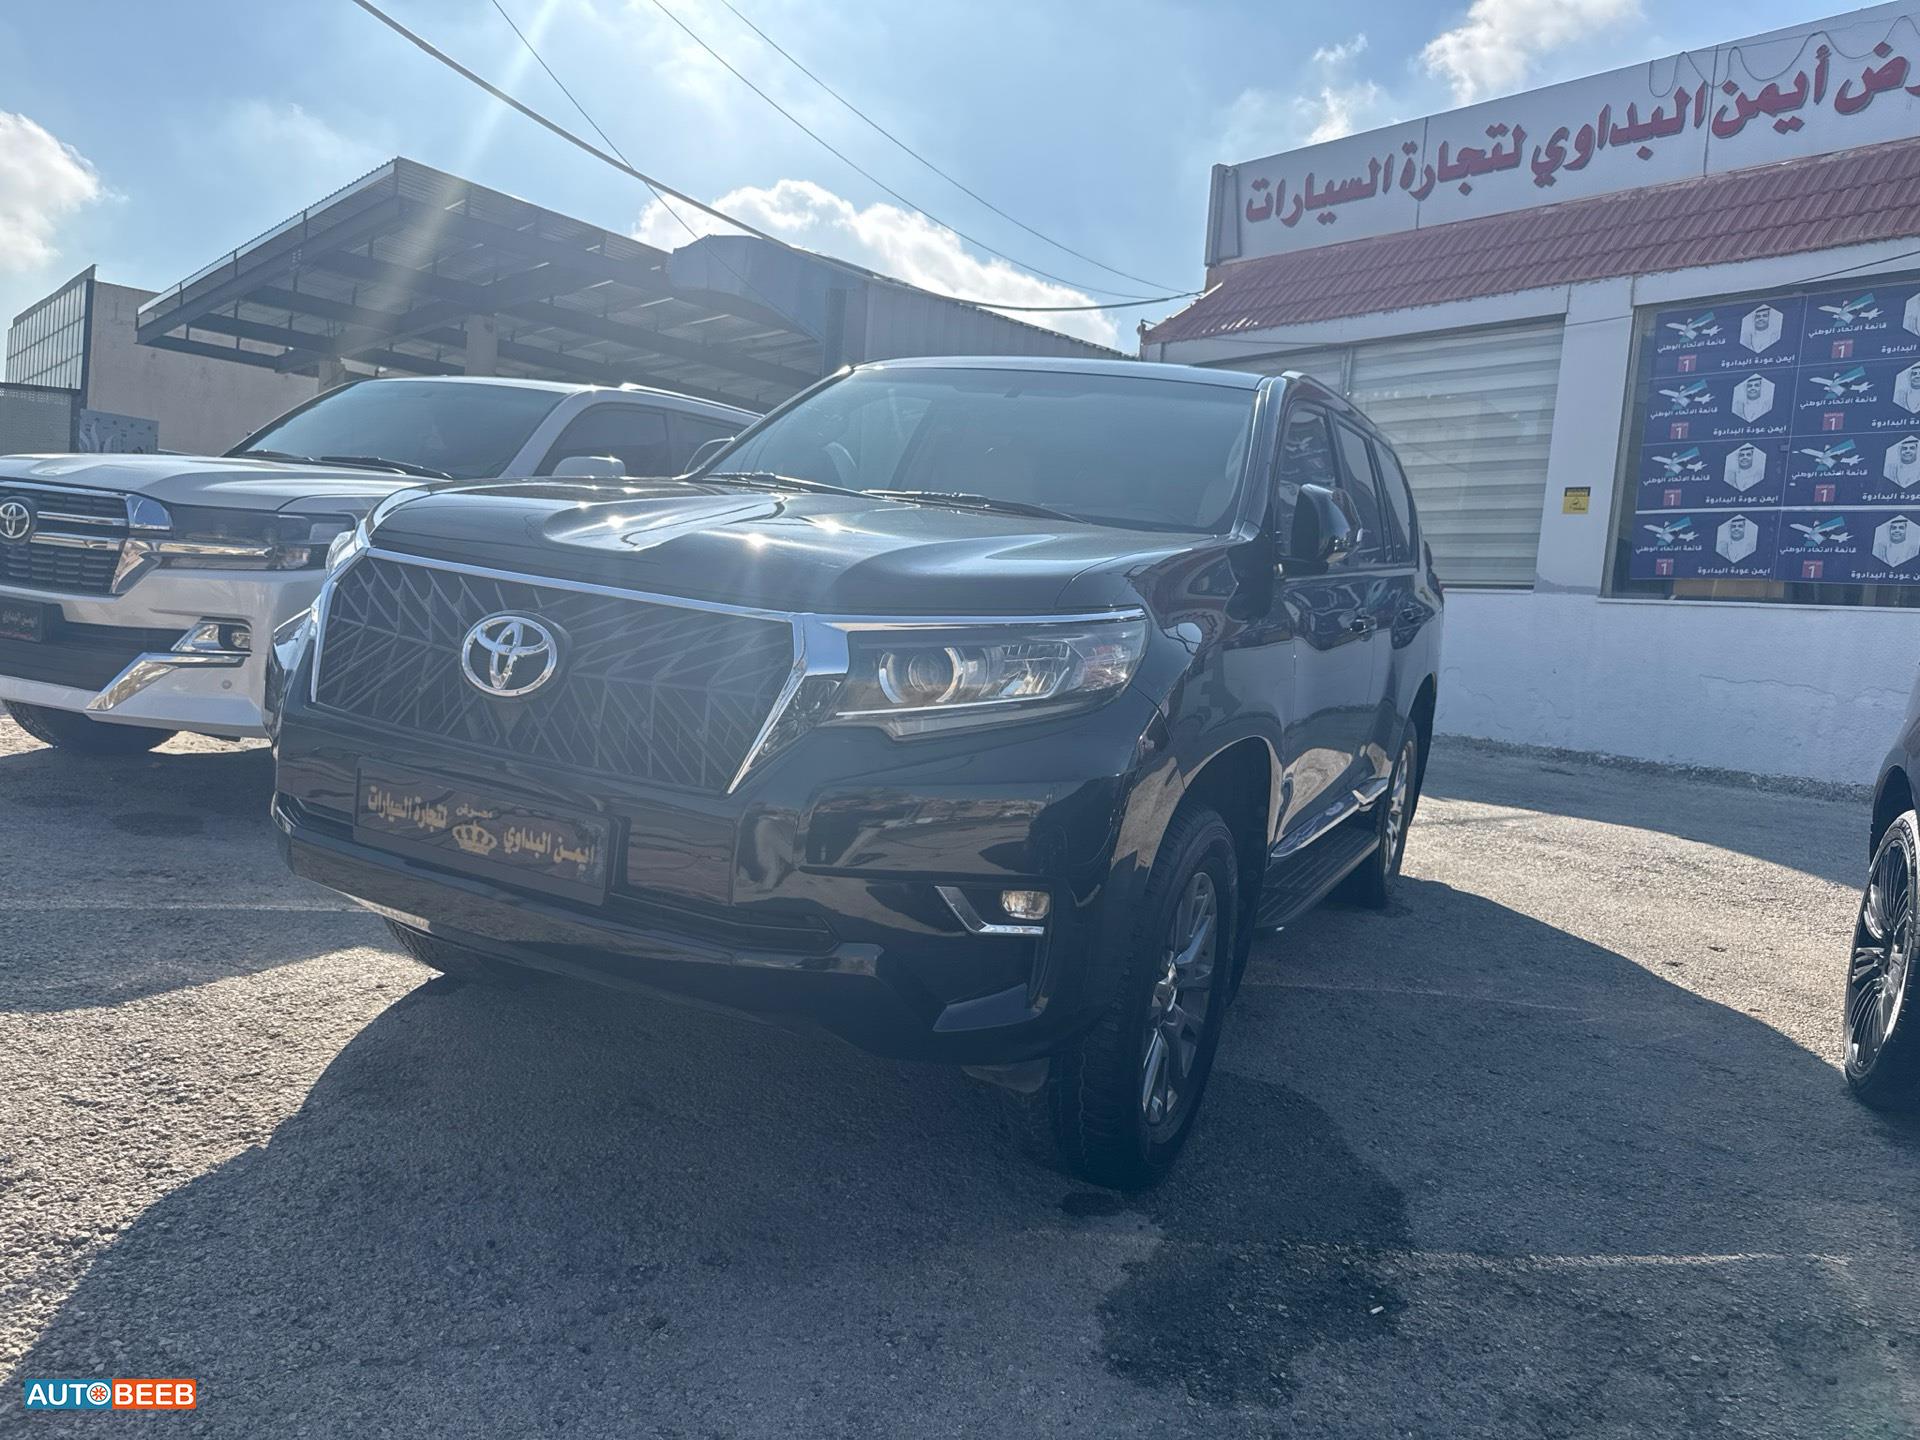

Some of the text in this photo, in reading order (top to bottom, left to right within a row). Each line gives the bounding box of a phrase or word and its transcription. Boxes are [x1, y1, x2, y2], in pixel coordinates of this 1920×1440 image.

[1712, 44, 1831, 139] أيمن
[1531, 81, 1707, 188] البداوي
[1399, 122, 1528, 200] لتجارة
[1246, 153, 1395, 228] السيارات
[1838, 345, 1845, 358] 1
[1683, 360, 1690, 372] 1
[1829, 418, 1836, 431] 1
[1676, 427, 1682, 439] 1
[1669, 494, 1675, 506] 1
[1821, 489, 1828, 502] 1
[1661, 563, 1667, 576] 1
[1808, 565, 1816, 578] 1
[368, 785, 412, 822] السيارات
[414, 796, 448, 832] لتجارة
[504, 827, 551, 859] البداوي
